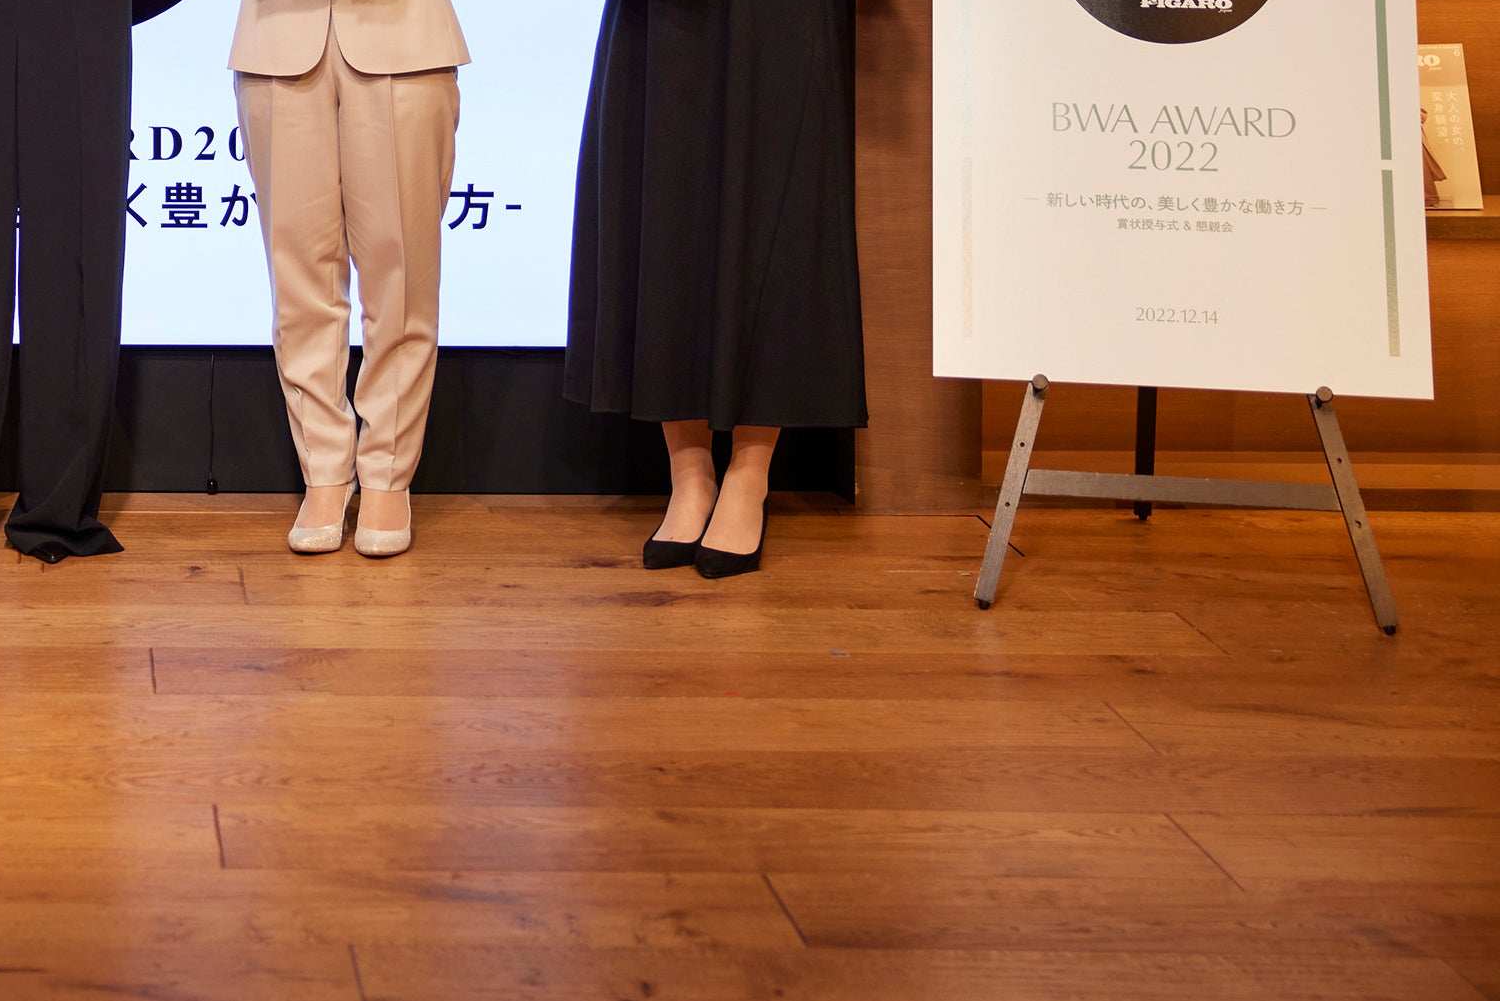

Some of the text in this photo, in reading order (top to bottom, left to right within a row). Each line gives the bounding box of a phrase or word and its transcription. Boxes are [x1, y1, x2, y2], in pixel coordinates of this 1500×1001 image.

[1051, 102, 1297, 138] BWA AWARD
[1446, 91, 1465, 151] 大人の女の、
[1127, 139, 1220, 172] 2022
[1046, 192, 1304, 216] 新しい時代の、美しく豊かな働き方
[1116, 218, 1234, 233] 賞状授与式 & 懇親会
[1135, 307, 1219, 324] 2022.12.14
